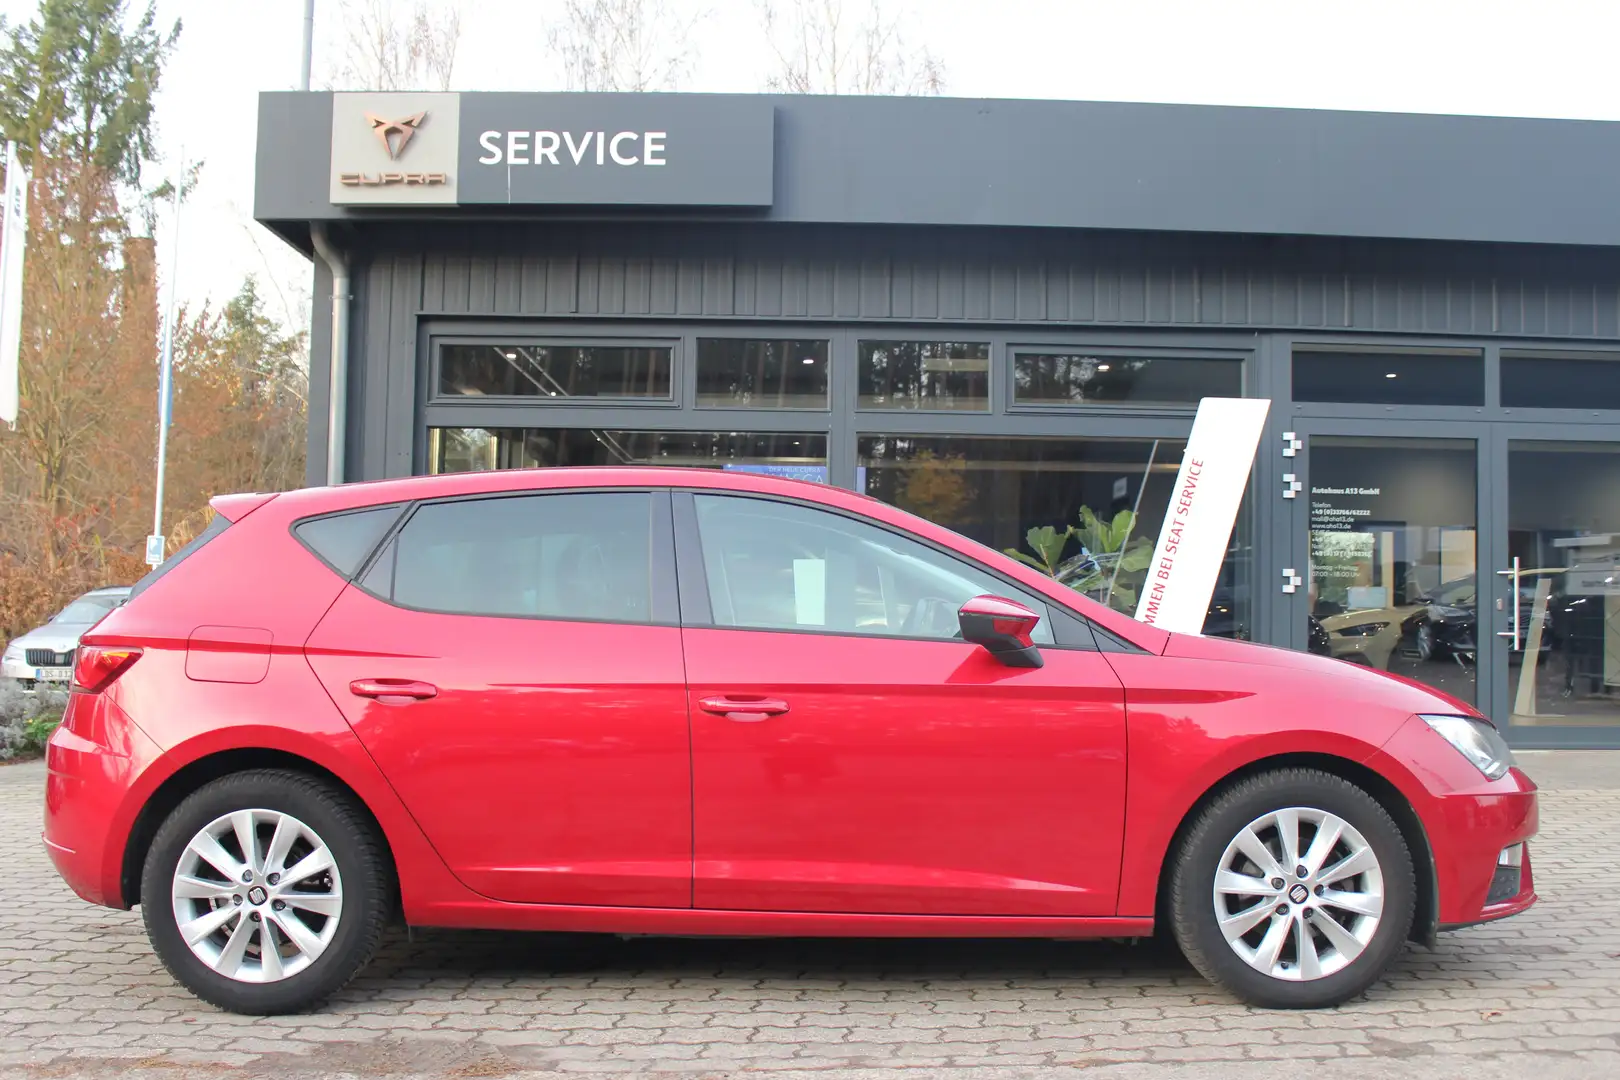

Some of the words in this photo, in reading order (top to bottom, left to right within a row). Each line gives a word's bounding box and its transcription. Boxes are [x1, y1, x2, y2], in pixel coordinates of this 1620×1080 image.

[479, 131, 667, 165] SERVICE
[339, 172, 447, 187] CUPRA
[1176, 458, 1204, 516] SERVICE
[1165, 518, 1185, 555] SEAT
[1157, 557, 1174, 580] BEI
